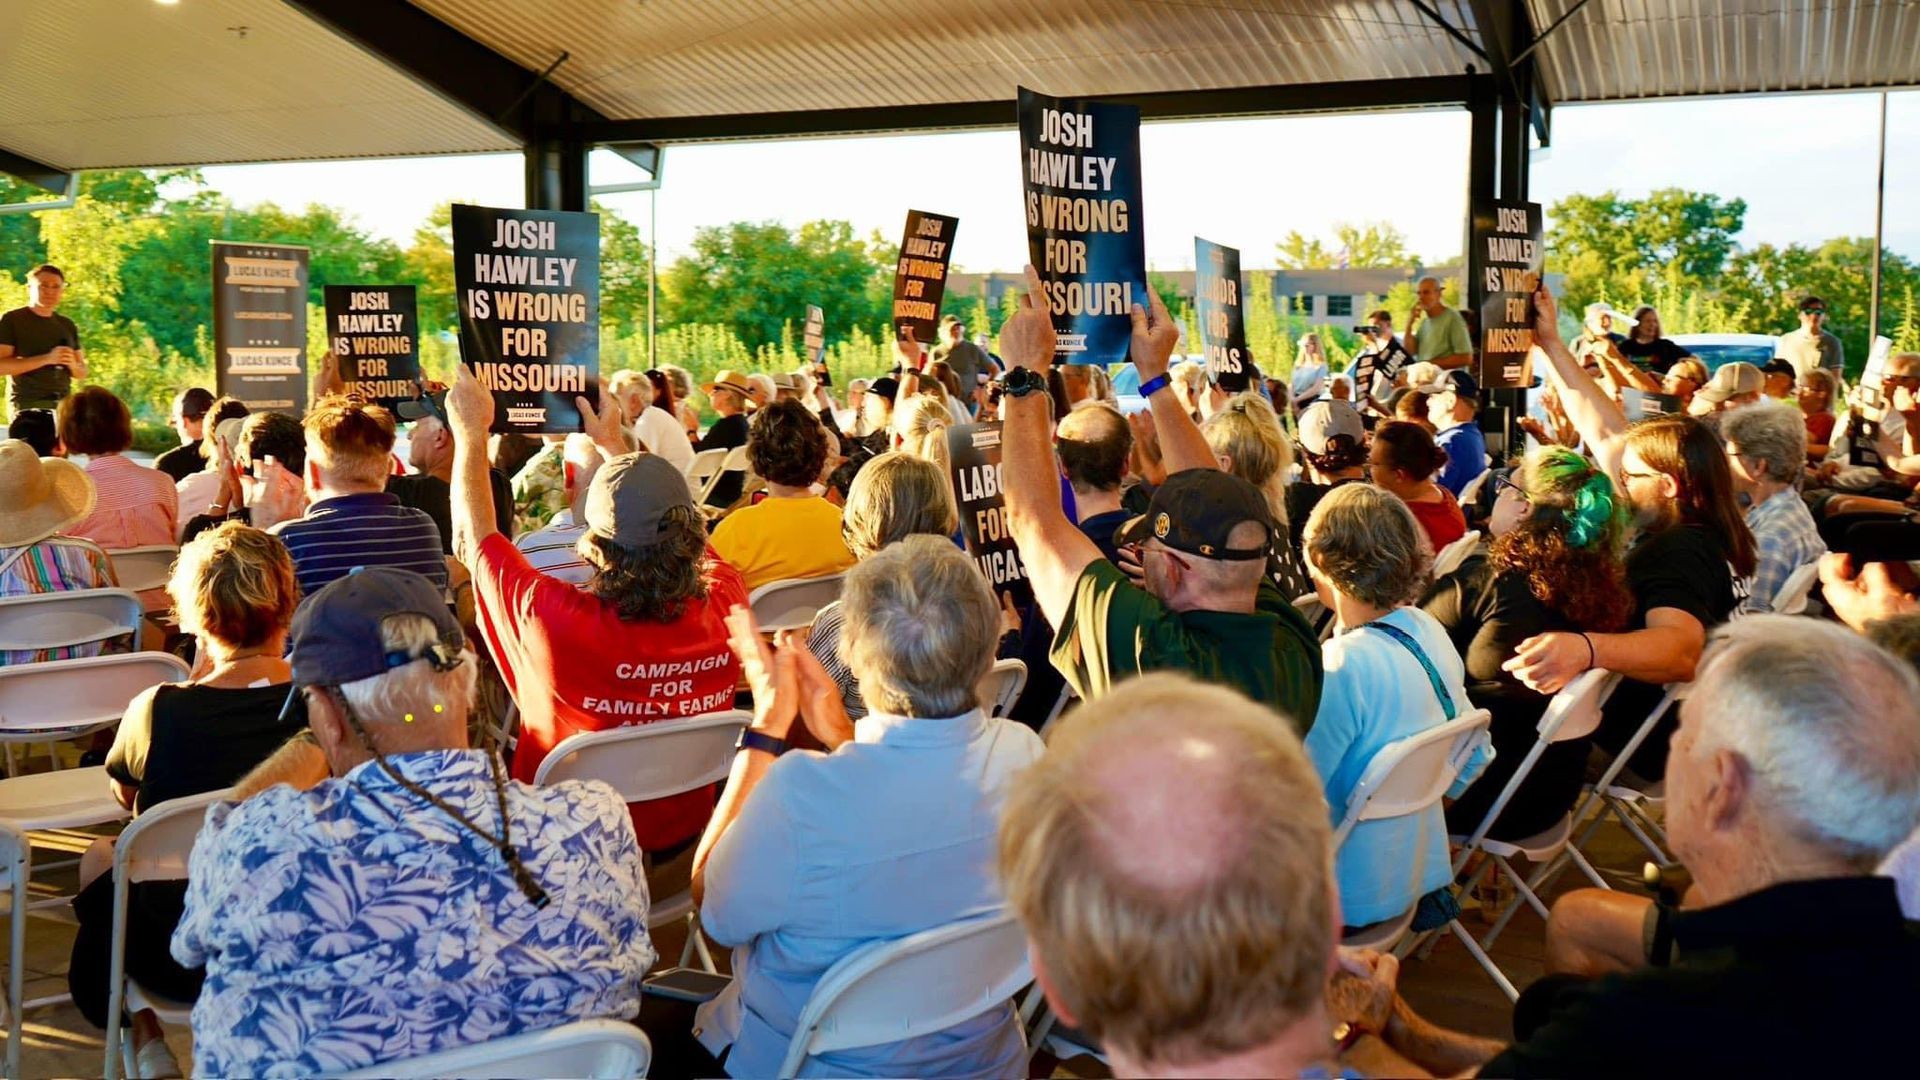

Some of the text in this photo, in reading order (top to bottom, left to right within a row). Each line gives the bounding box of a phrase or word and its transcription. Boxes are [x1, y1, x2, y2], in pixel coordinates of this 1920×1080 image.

[1040, 108, 1093, 148] JOSH
[1029, 148, 1117, 191] HAWLEY
[1027, 190, 1129, 233] IS WRONG
[1496, 208, 1528, 233] JOSH
[492, 219, 556, 250] JOSH
[1045, 238, 1087, 274] FOR
[233, 265, 262, 277] LUCAS
[474, 253, 577, 287] HAWLEY
[1485, 266, 1501, 292] IS
[349, 292, 390, 310] JOSH
[904, 280, 925, 298] FOR
[1040, 280, 1132, 316] SSOURI
[467, 289, 586, 322] IS WRONG
[1505, 298, 1526, 323] FOR
[338, 314, 403, 333] HAWLEY
[334, 336, 411, 355] IS WRONG
[502, 327, 548, 357] FOR
[235, 356, 262, 366] LUCAS
[357, 359, 388, 377] FOR
[345, 380, 412, 398] ISSOUR
[474, 361, 586, 392] MISSOURI
[959, 462, 1005, 502] LABO
[616, 652, 730, 679] CAMPAIGN
[649, 679, 693, 698] FOR
[582, 696, 670, 715] FAMILY
